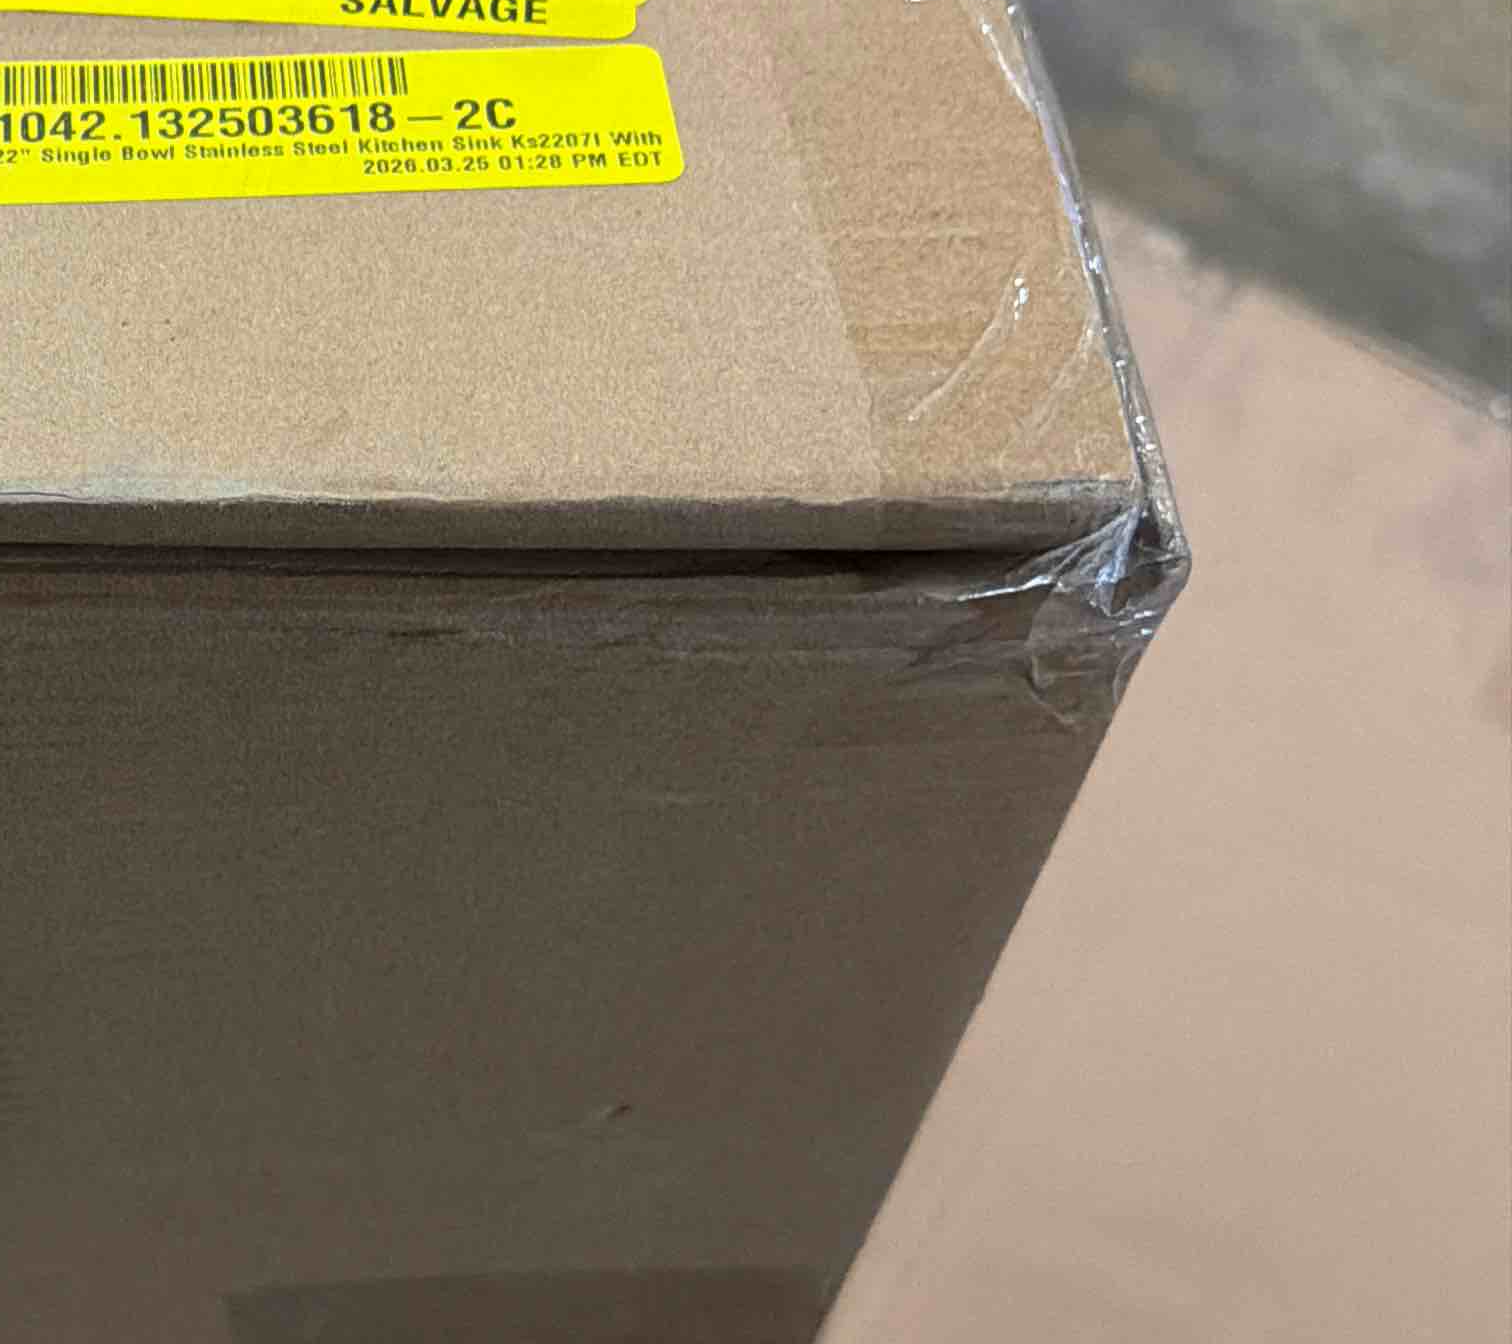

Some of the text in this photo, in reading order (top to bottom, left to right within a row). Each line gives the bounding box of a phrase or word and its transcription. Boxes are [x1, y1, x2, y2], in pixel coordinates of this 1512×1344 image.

[40, 146, 112, 167] Single
[120, 145, 175, 162] Bowl
[184, 142, 285, 161] Stainless
[292, 139, 349, 157] Steel
[358, 137, 444, 155] Kitchen
[452, 134, 504, 152] Sink
[609, 129, 663, 146] With
[498, 154, 562, 173] 01:28
[571, 152, 607, 170] PM
[617, 150, 663, 168] EDT
